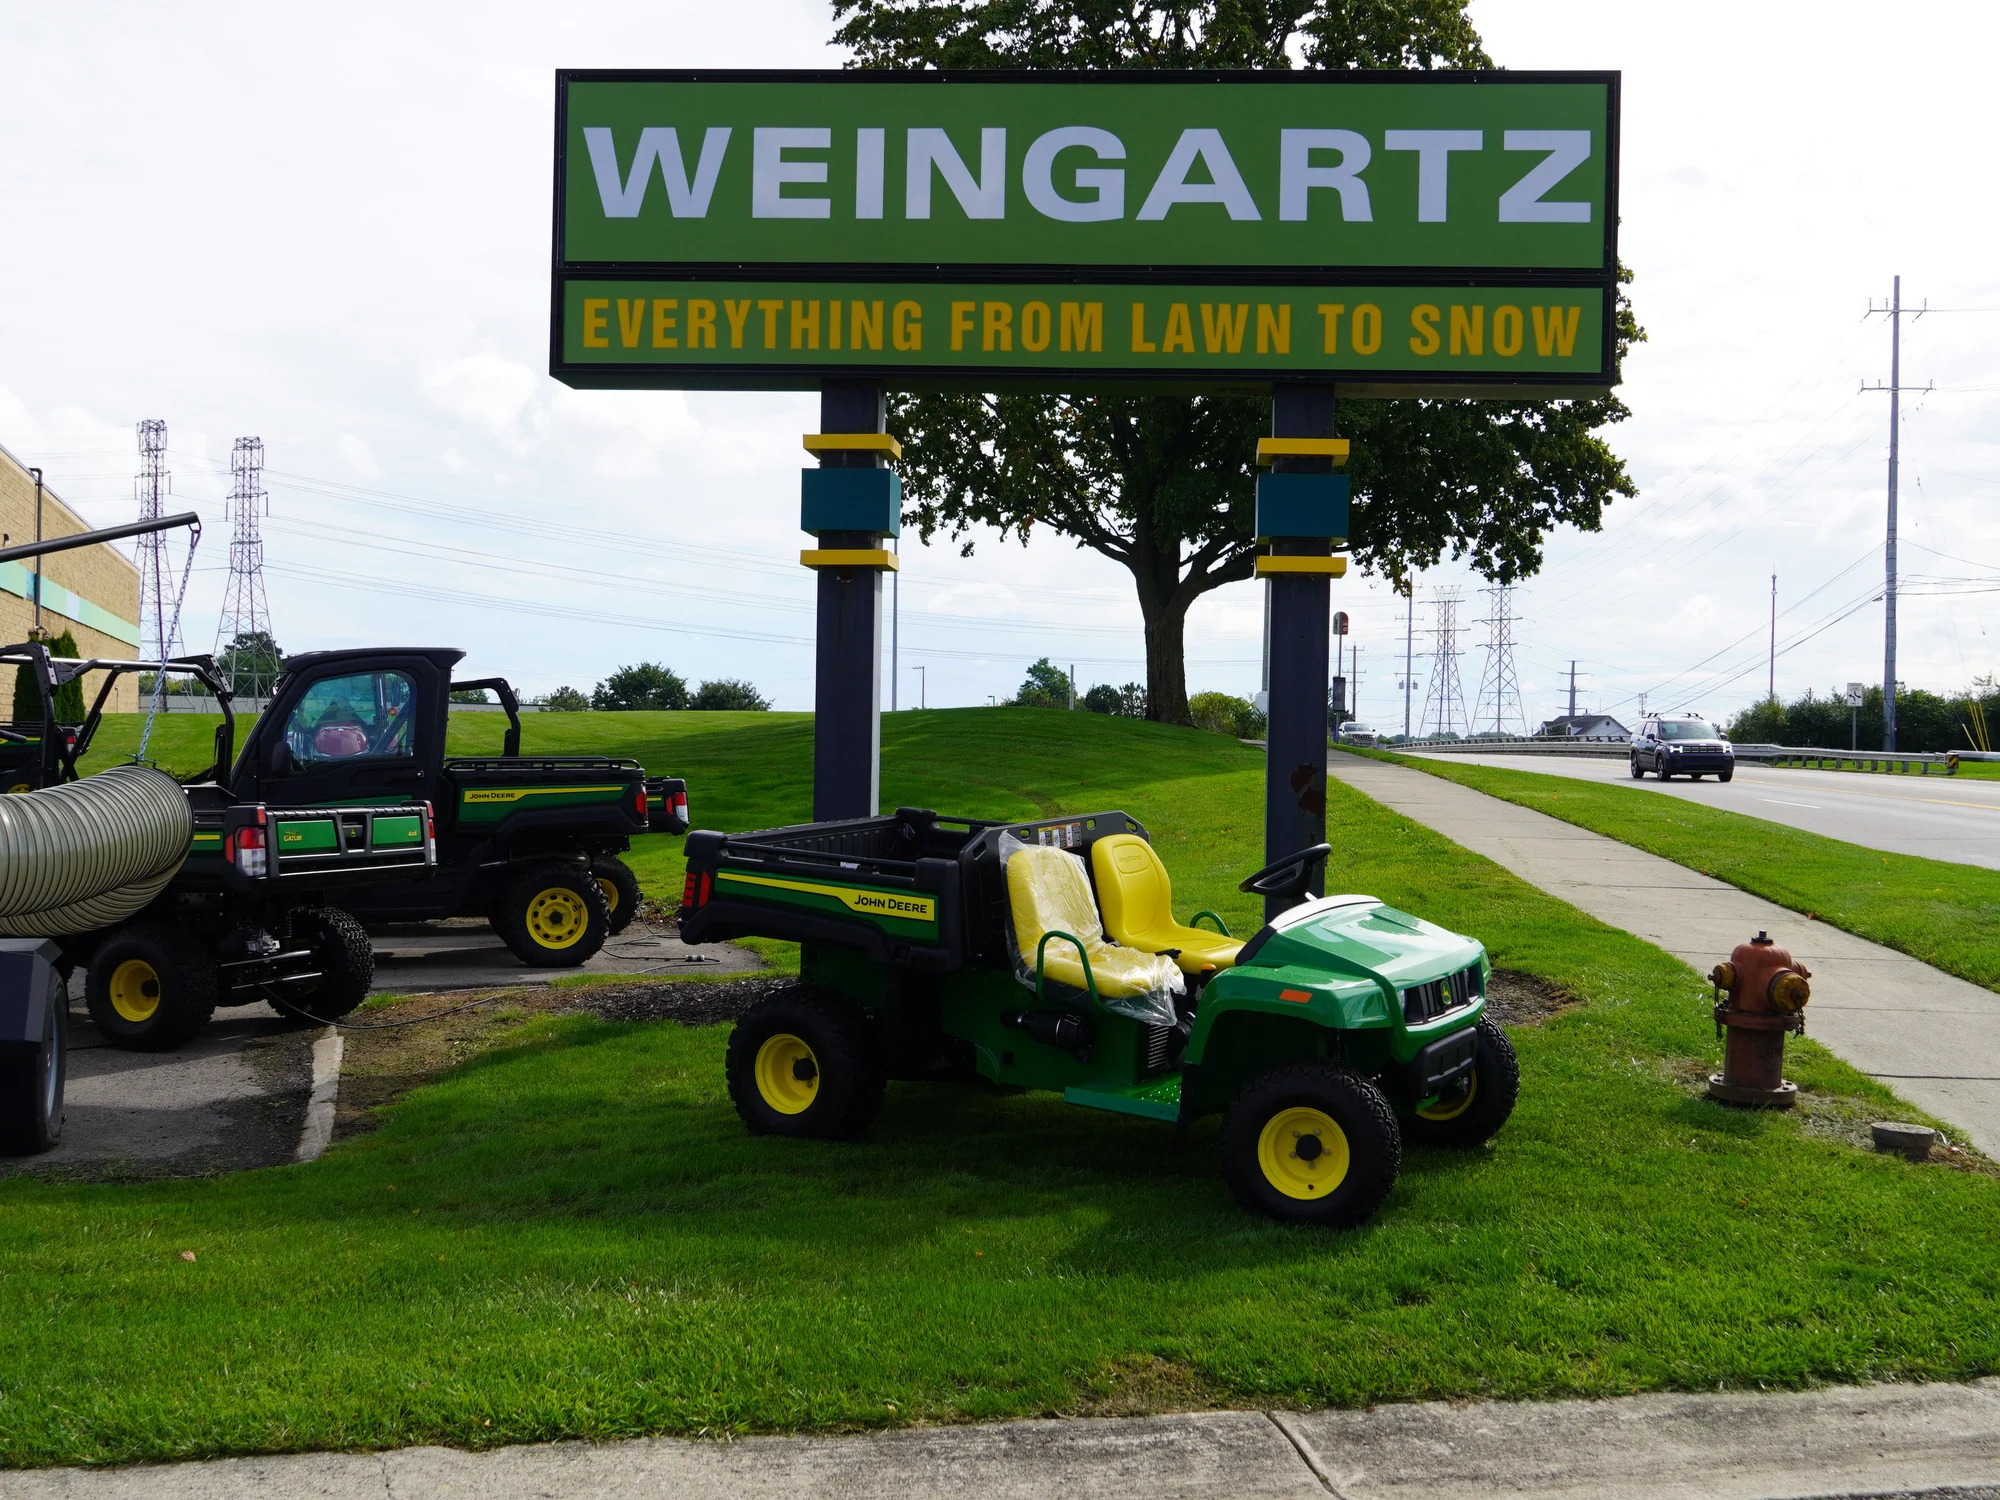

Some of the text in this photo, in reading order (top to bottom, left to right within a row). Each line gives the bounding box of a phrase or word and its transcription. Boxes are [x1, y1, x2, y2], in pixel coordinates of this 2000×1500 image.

[582, 126, 1593, 223] WEINGARTZ
[583, 298, 1582, 357] EVERYTHING FROM LAWN TO SNOW
[854, 894, 928, 914] JOHN DEERE
